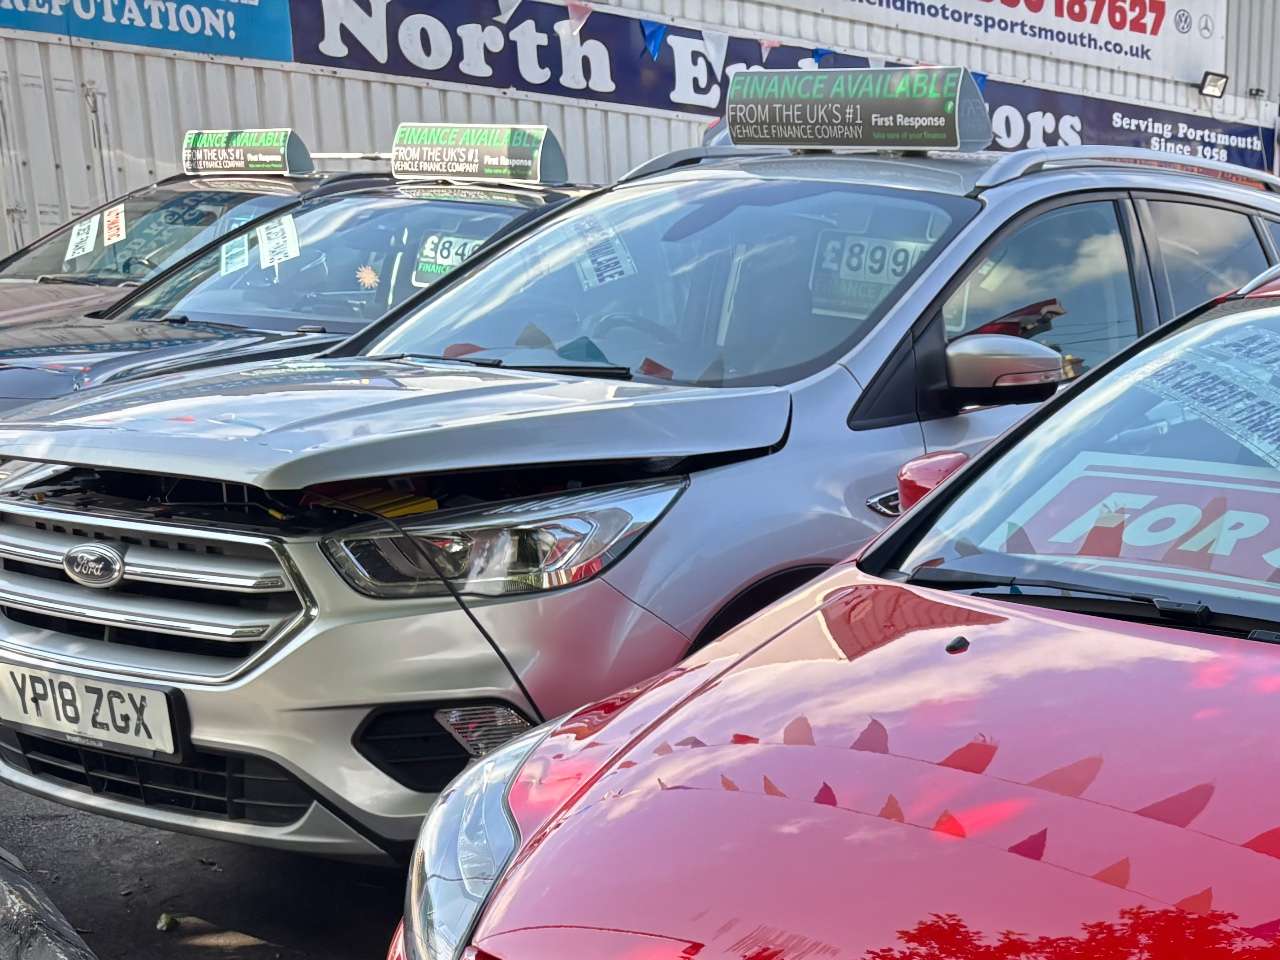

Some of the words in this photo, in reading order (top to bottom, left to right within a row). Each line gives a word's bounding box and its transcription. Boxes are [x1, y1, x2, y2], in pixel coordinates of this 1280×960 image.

[318, 0, 616, 94] North
[986, 102, 1083, 150] ors
[731, 75, 828, 99] FINANCE
[830, 72, 959, 99] AVAILABLE
[728, 104, 772, 123] FROM
[773, 104, 802, 123] THE
[806, 103, 841, 123] UK'S
[845, 104, 863, 124] #1
[872, 114, 893, 126] First
[896, 114, 945, 128] Response
[185, 131, 227, 148] FINANCE
[230, 131, 287, 147] AVAILABLE
[396, 127, 457, 146] FINANCE
[460, 127, 544, 148] AVAILABLE
[731, 124, 770, 138] VEHICLE
[771, 125, 814, 139] FINANCE
[815, 125, 863, 139] COMPANY
[1111, 112, 1173, 139] Serving
[1177, 122, 1263, 152] Portsmouth
[203, 149, 218, 160] THE
[394, 147, 420, 162] FROM
[421, 148, 441, 162] THE
[468, 148, 479, 163] #1
[1149, 136, 1191, 156] Since
[1196, 144, 1228, 163] 1958
[393, 161, 418, 172] VEHICLE
[419, 162, 447, 173] FINANCE
[447, 162, 479, 173] COMPANY
[821, 239, 918, 278] £899
[1047, 491, 1271, 558] FOR
[73, 553, 104, 577] Ford
[9, 670, 81, 725] YP18
[84, 685, 153, 740] ZGX
